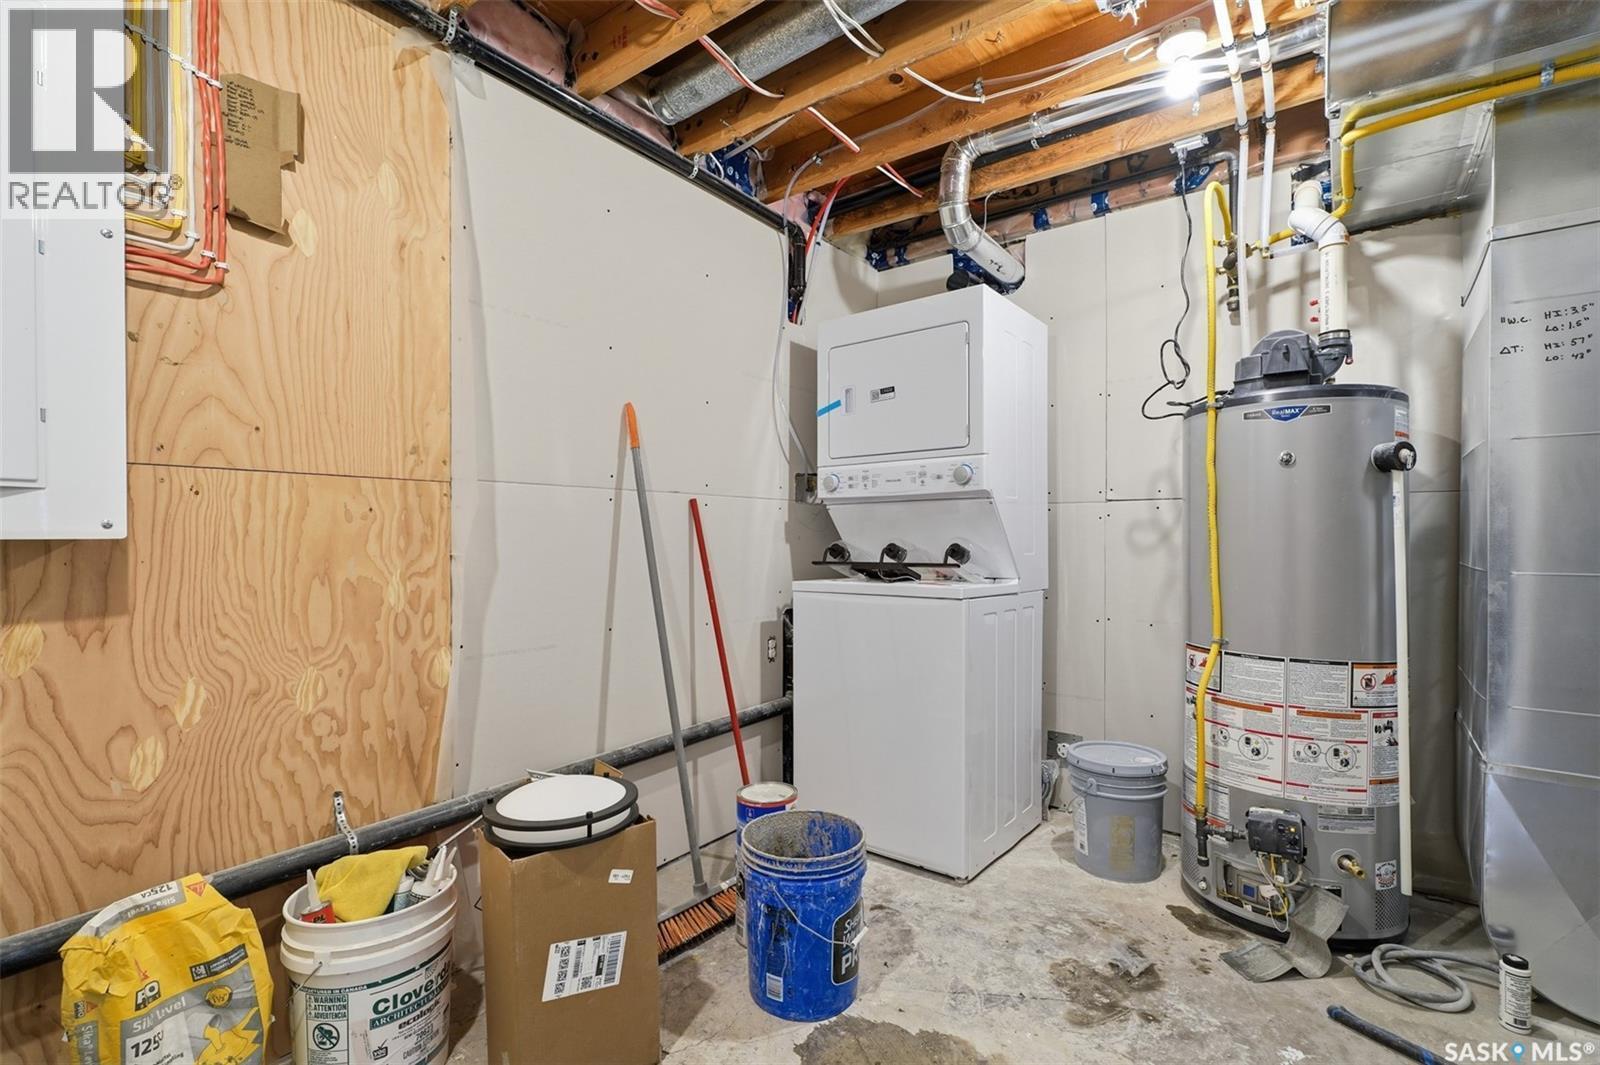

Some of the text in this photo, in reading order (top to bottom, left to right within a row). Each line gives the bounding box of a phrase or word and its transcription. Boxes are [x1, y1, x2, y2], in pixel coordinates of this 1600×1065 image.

[313, 995, 347, 1004] WARNING
[313, 1003, 347, 1011] ATTENTION
[313, 1011, 347, 1019] ADVERTENCIA
